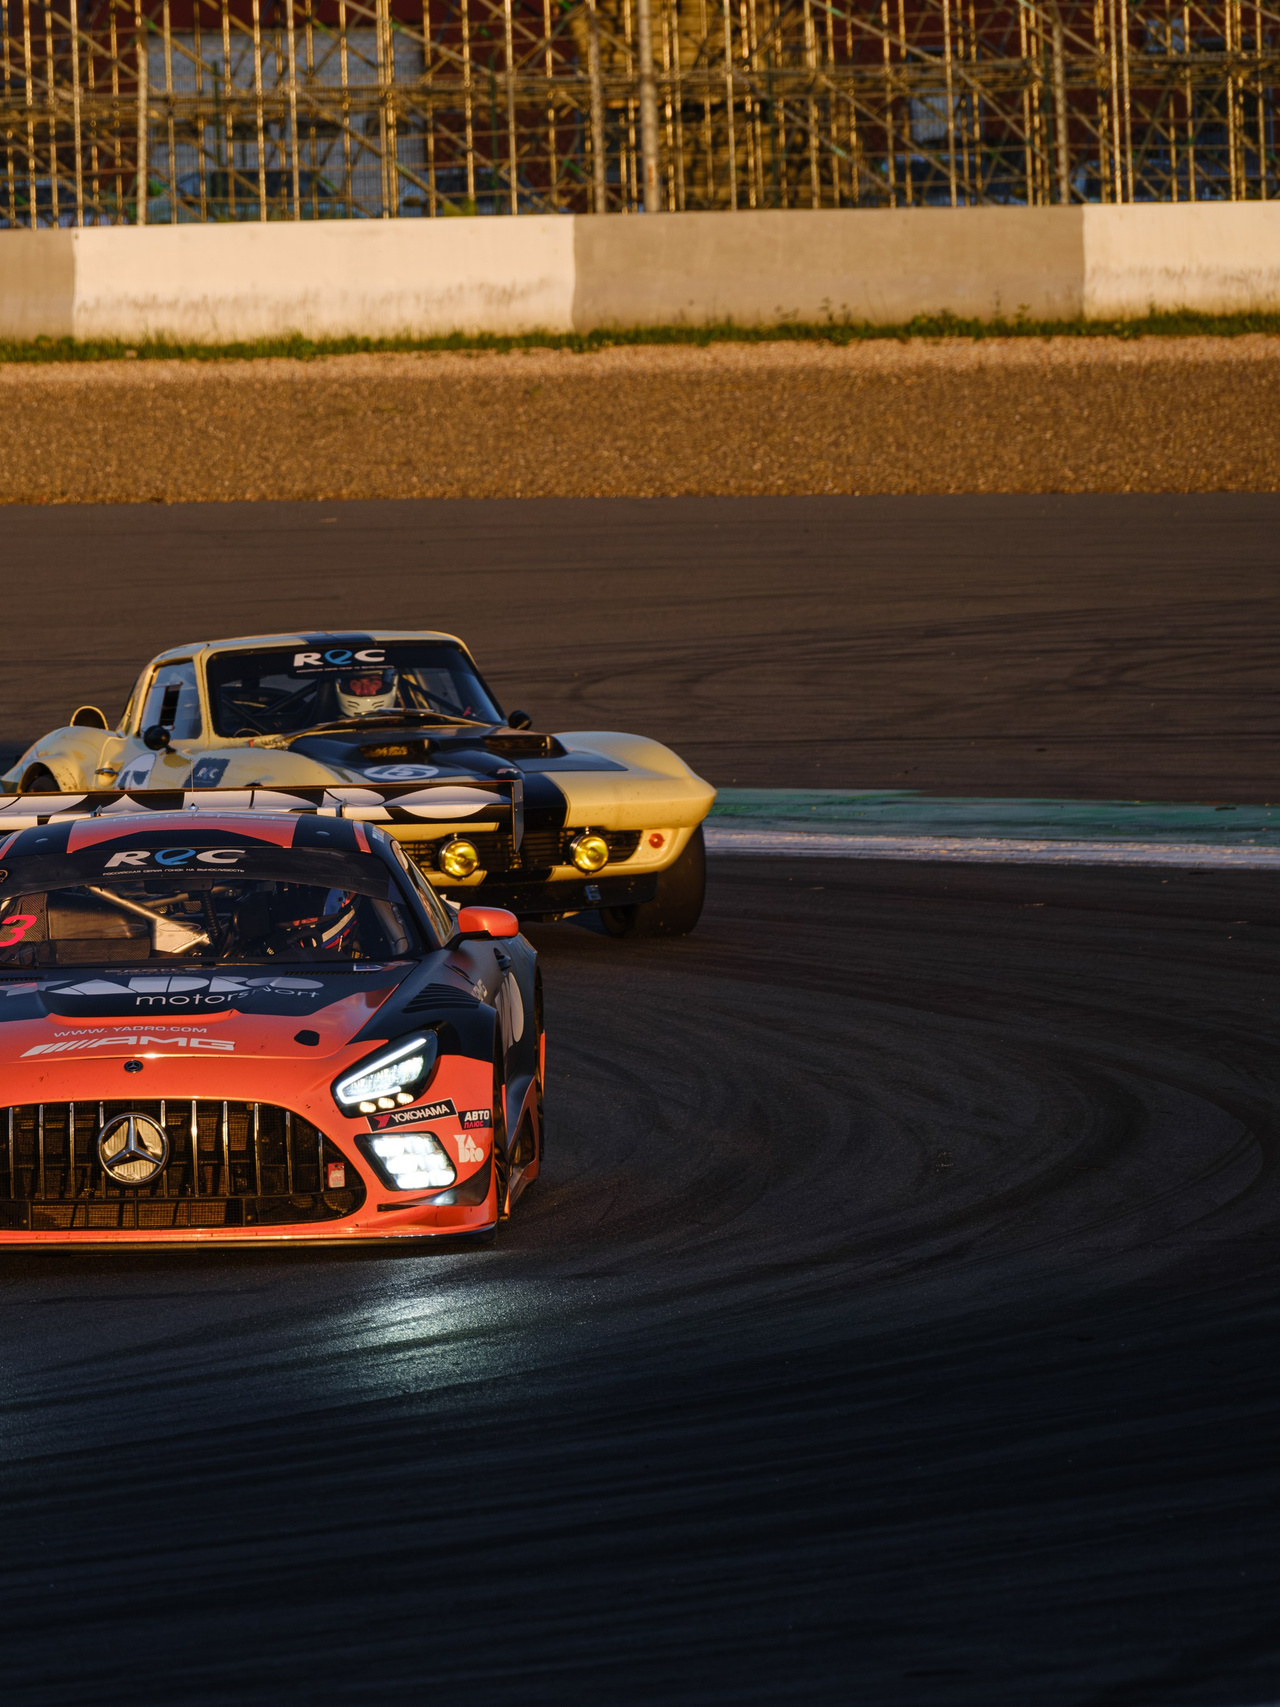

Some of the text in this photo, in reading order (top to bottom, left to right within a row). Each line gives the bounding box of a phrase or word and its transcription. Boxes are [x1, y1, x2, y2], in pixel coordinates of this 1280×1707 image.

[86, 1035, 236, 1051] AMG
[391, 1104, 451, 1123] YOKOHAMA
[464, 1110, 490, 1122] АВТО
[463, 1120, 484, 1129] ПЛЮС
